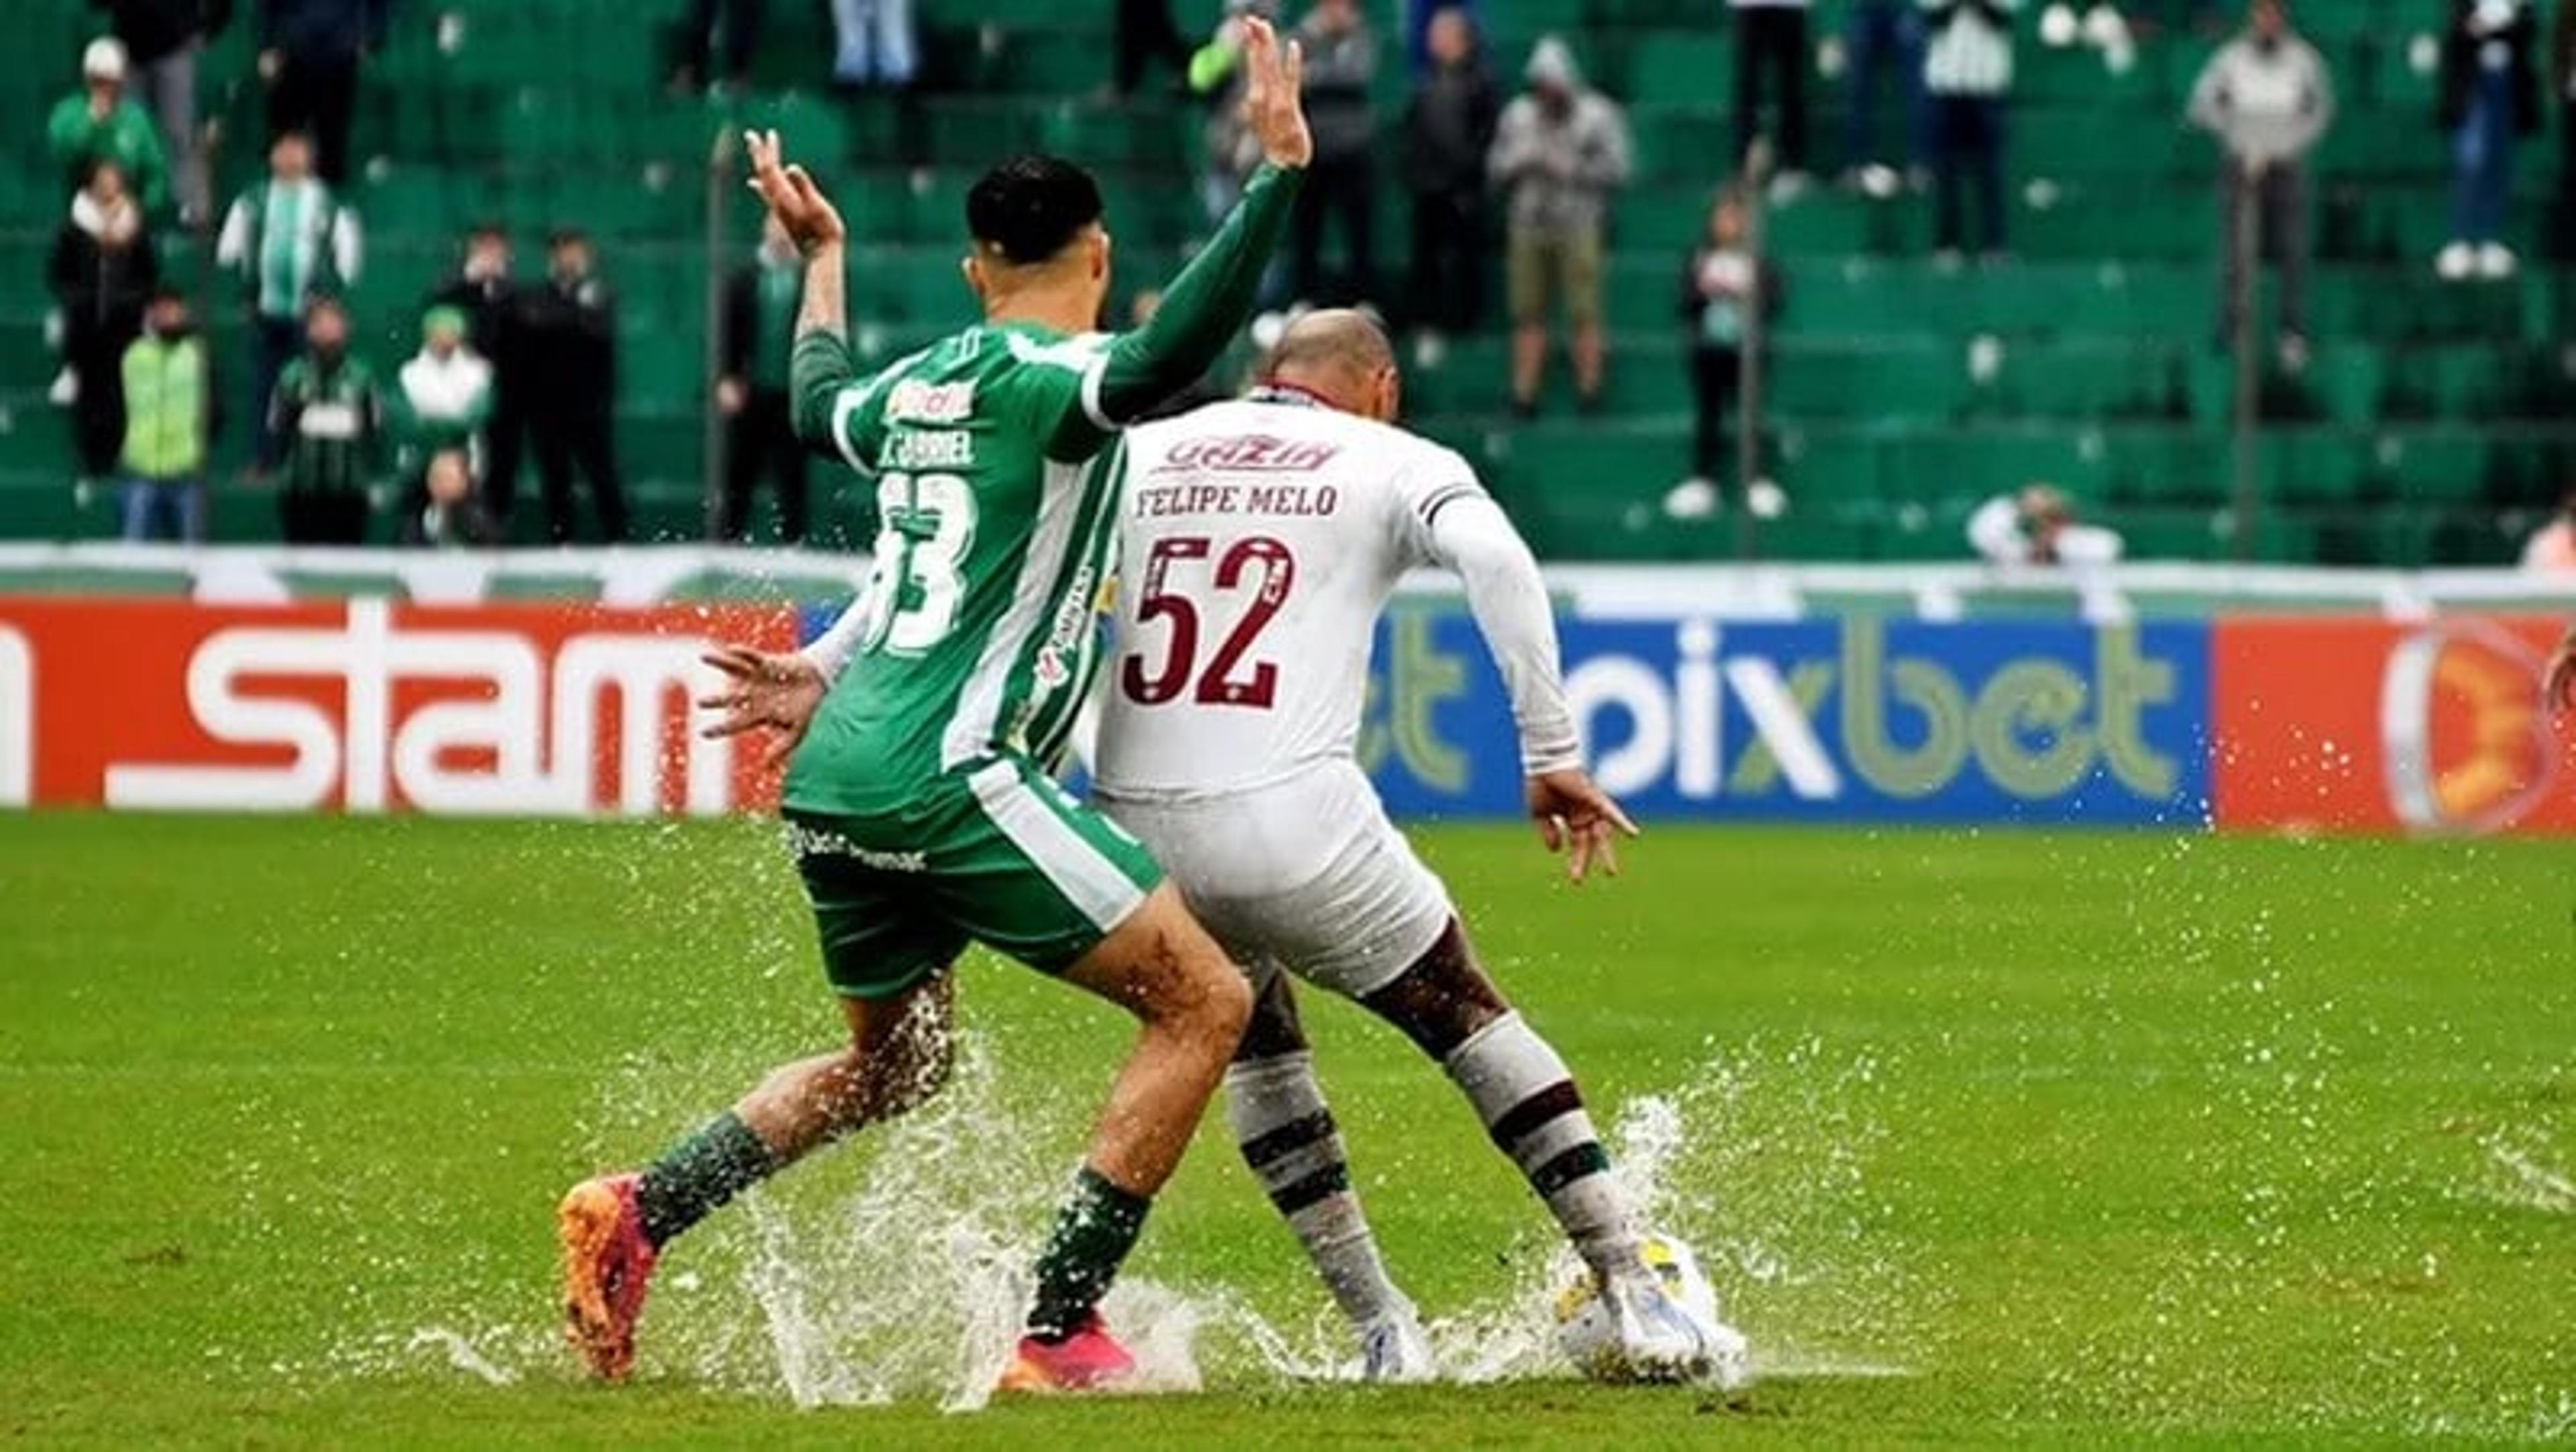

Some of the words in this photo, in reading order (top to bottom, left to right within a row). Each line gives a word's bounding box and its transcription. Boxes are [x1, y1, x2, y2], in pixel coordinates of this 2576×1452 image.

[1137, 485, 1240, 517] FELIPE
[1246, 485, 1338, 516] MELO
[105, 597, 731, 813] stam
[1122, 537, 1295, 710] 52
[1566, 607, 2175, 798] pixbet
